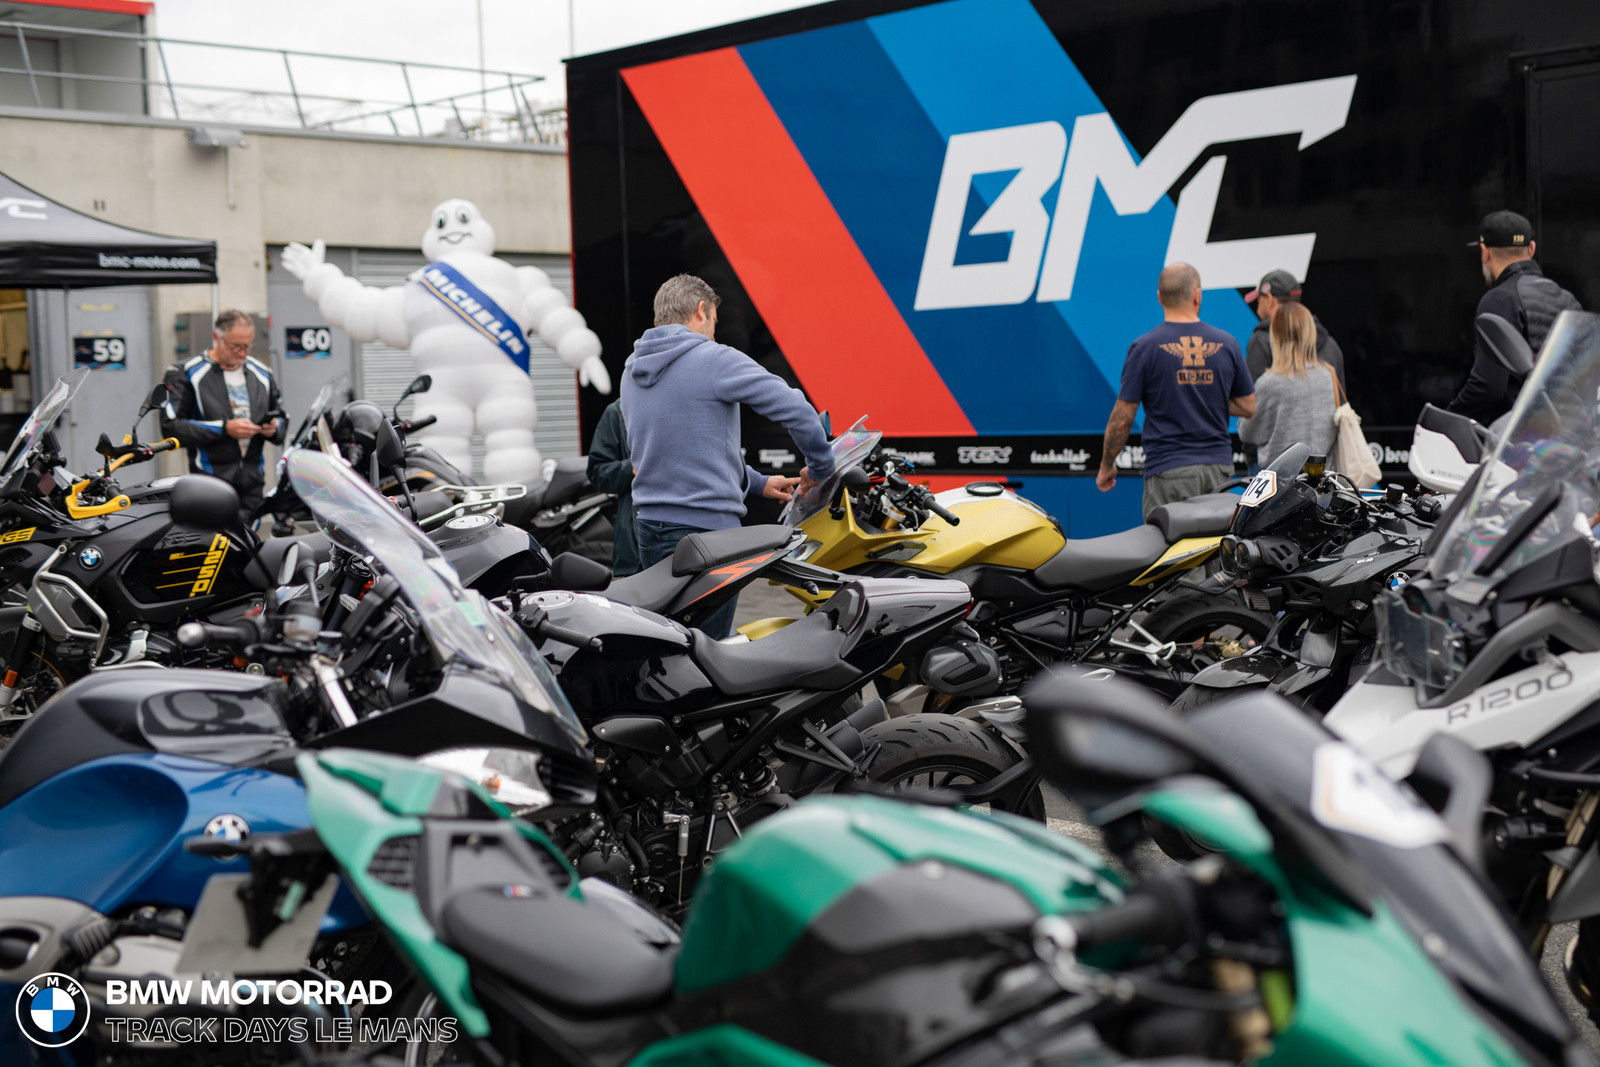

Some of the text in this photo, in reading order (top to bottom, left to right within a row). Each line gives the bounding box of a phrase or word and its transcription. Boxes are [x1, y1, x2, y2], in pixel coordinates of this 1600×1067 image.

[914, 75, 1358, 311] BMC
[99, 252, 201, 269] bmc-moto.com
[425, 268, 524, 355] MICHELIN
[92, 338, 125, 362] 59
[301, 328, 331, 350] 60
[1447, 668, 1574, 725] R 1200
